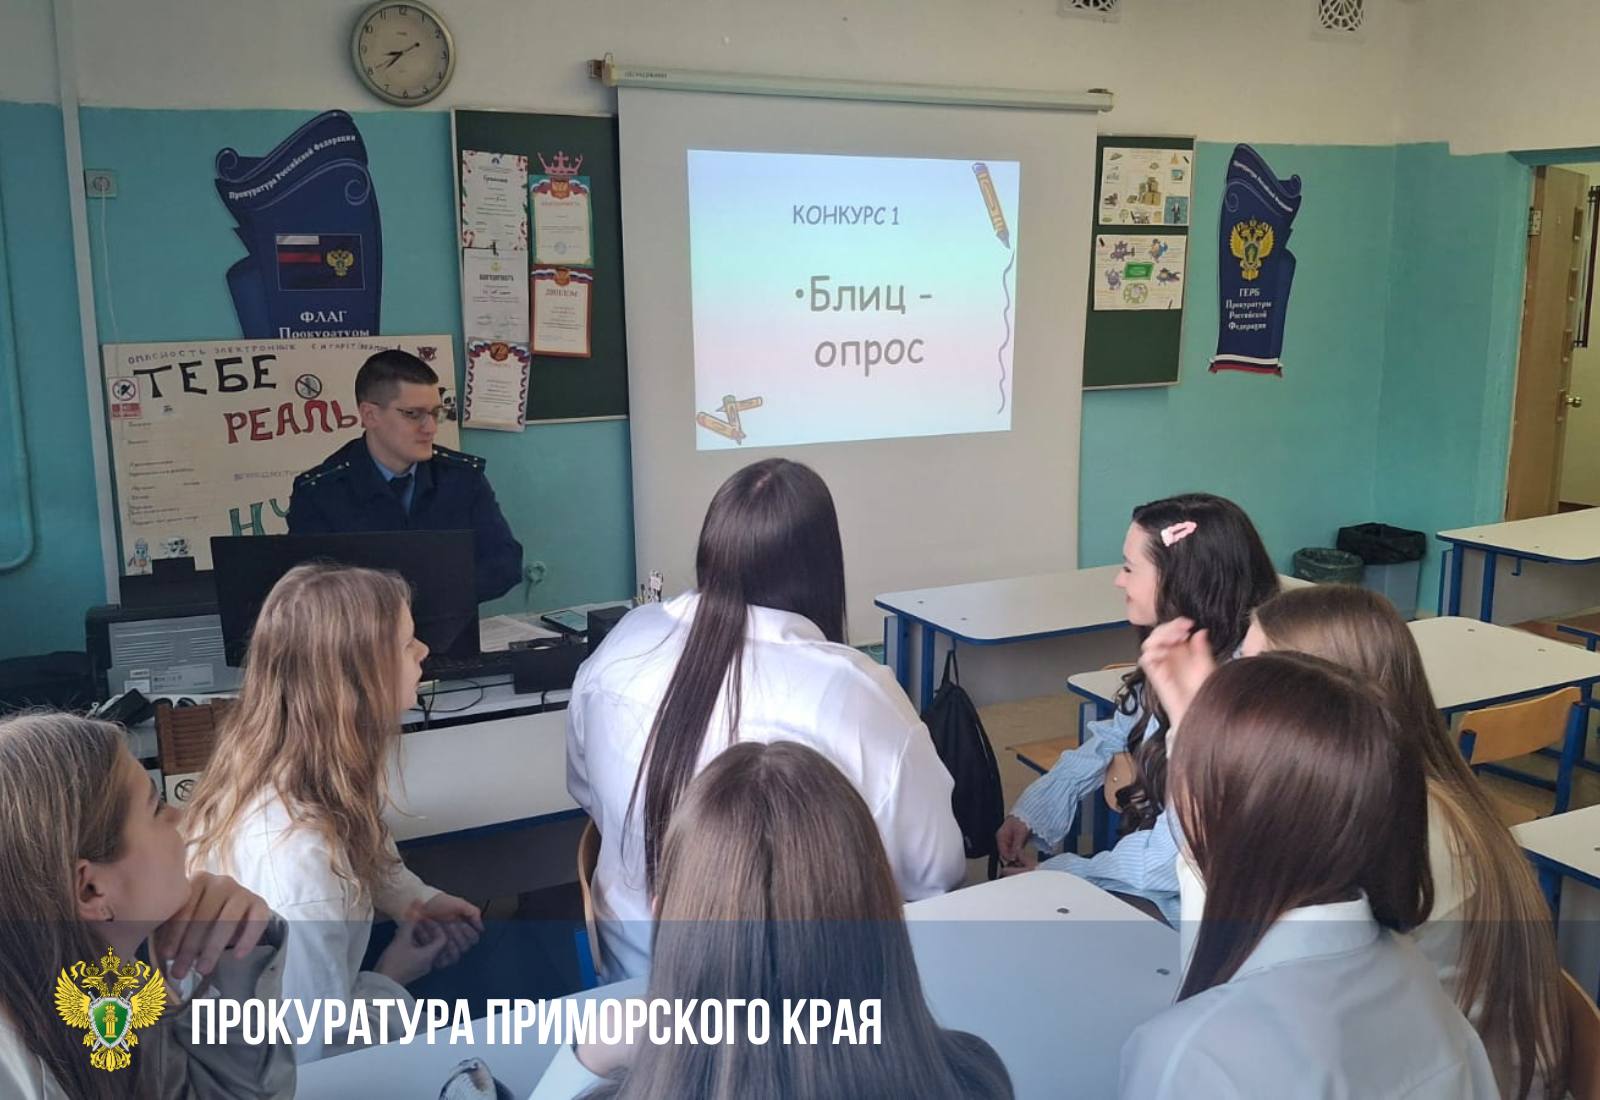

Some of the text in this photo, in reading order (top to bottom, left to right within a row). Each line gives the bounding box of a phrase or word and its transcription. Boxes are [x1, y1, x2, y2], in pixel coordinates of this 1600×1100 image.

[792, 204, 900, 226] КОНКУРС 1
[809, 275, 906, 314] Блиц
[1239, 288, 1261, 297] ГЕРБ
[299, 310, 348, 323] ФЛАГ
[133, 353, 277, 399] ТЕБЕ
[814, 338, 925, 377] опрос
[222, 399, 363, 444] РЕАЛЬ
